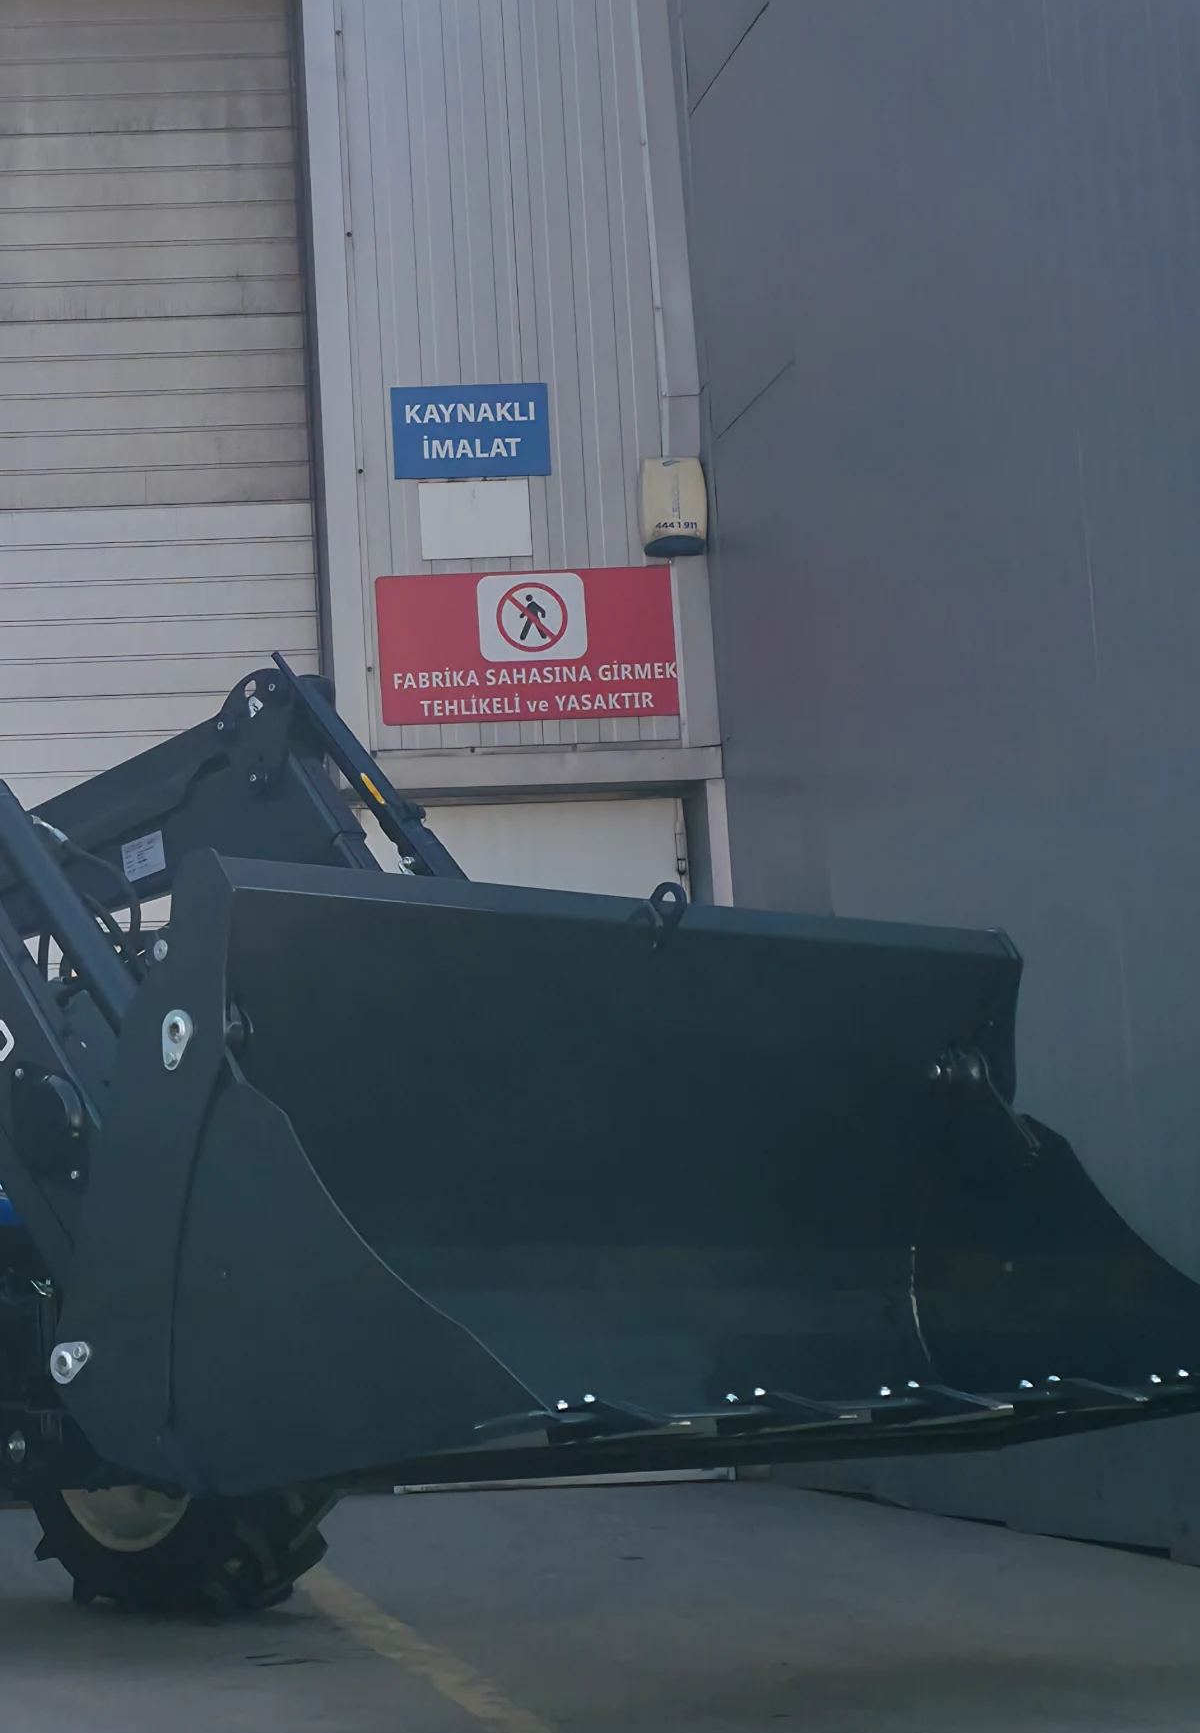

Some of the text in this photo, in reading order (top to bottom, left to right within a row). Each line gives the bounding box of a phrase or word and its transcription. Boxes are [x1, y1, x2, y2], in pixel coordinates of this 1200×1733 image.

[405, 401, 536, 424] KAYNAKLI
[422, 435, 521, 459] İMALAT
[655, 521, 675, 529] 444
[393, 660, 678, 689] FABRİKA SAHASINA GİRMEK
[420, 691, 655, 716] TEHLİKELİ ve YASAKTIR
